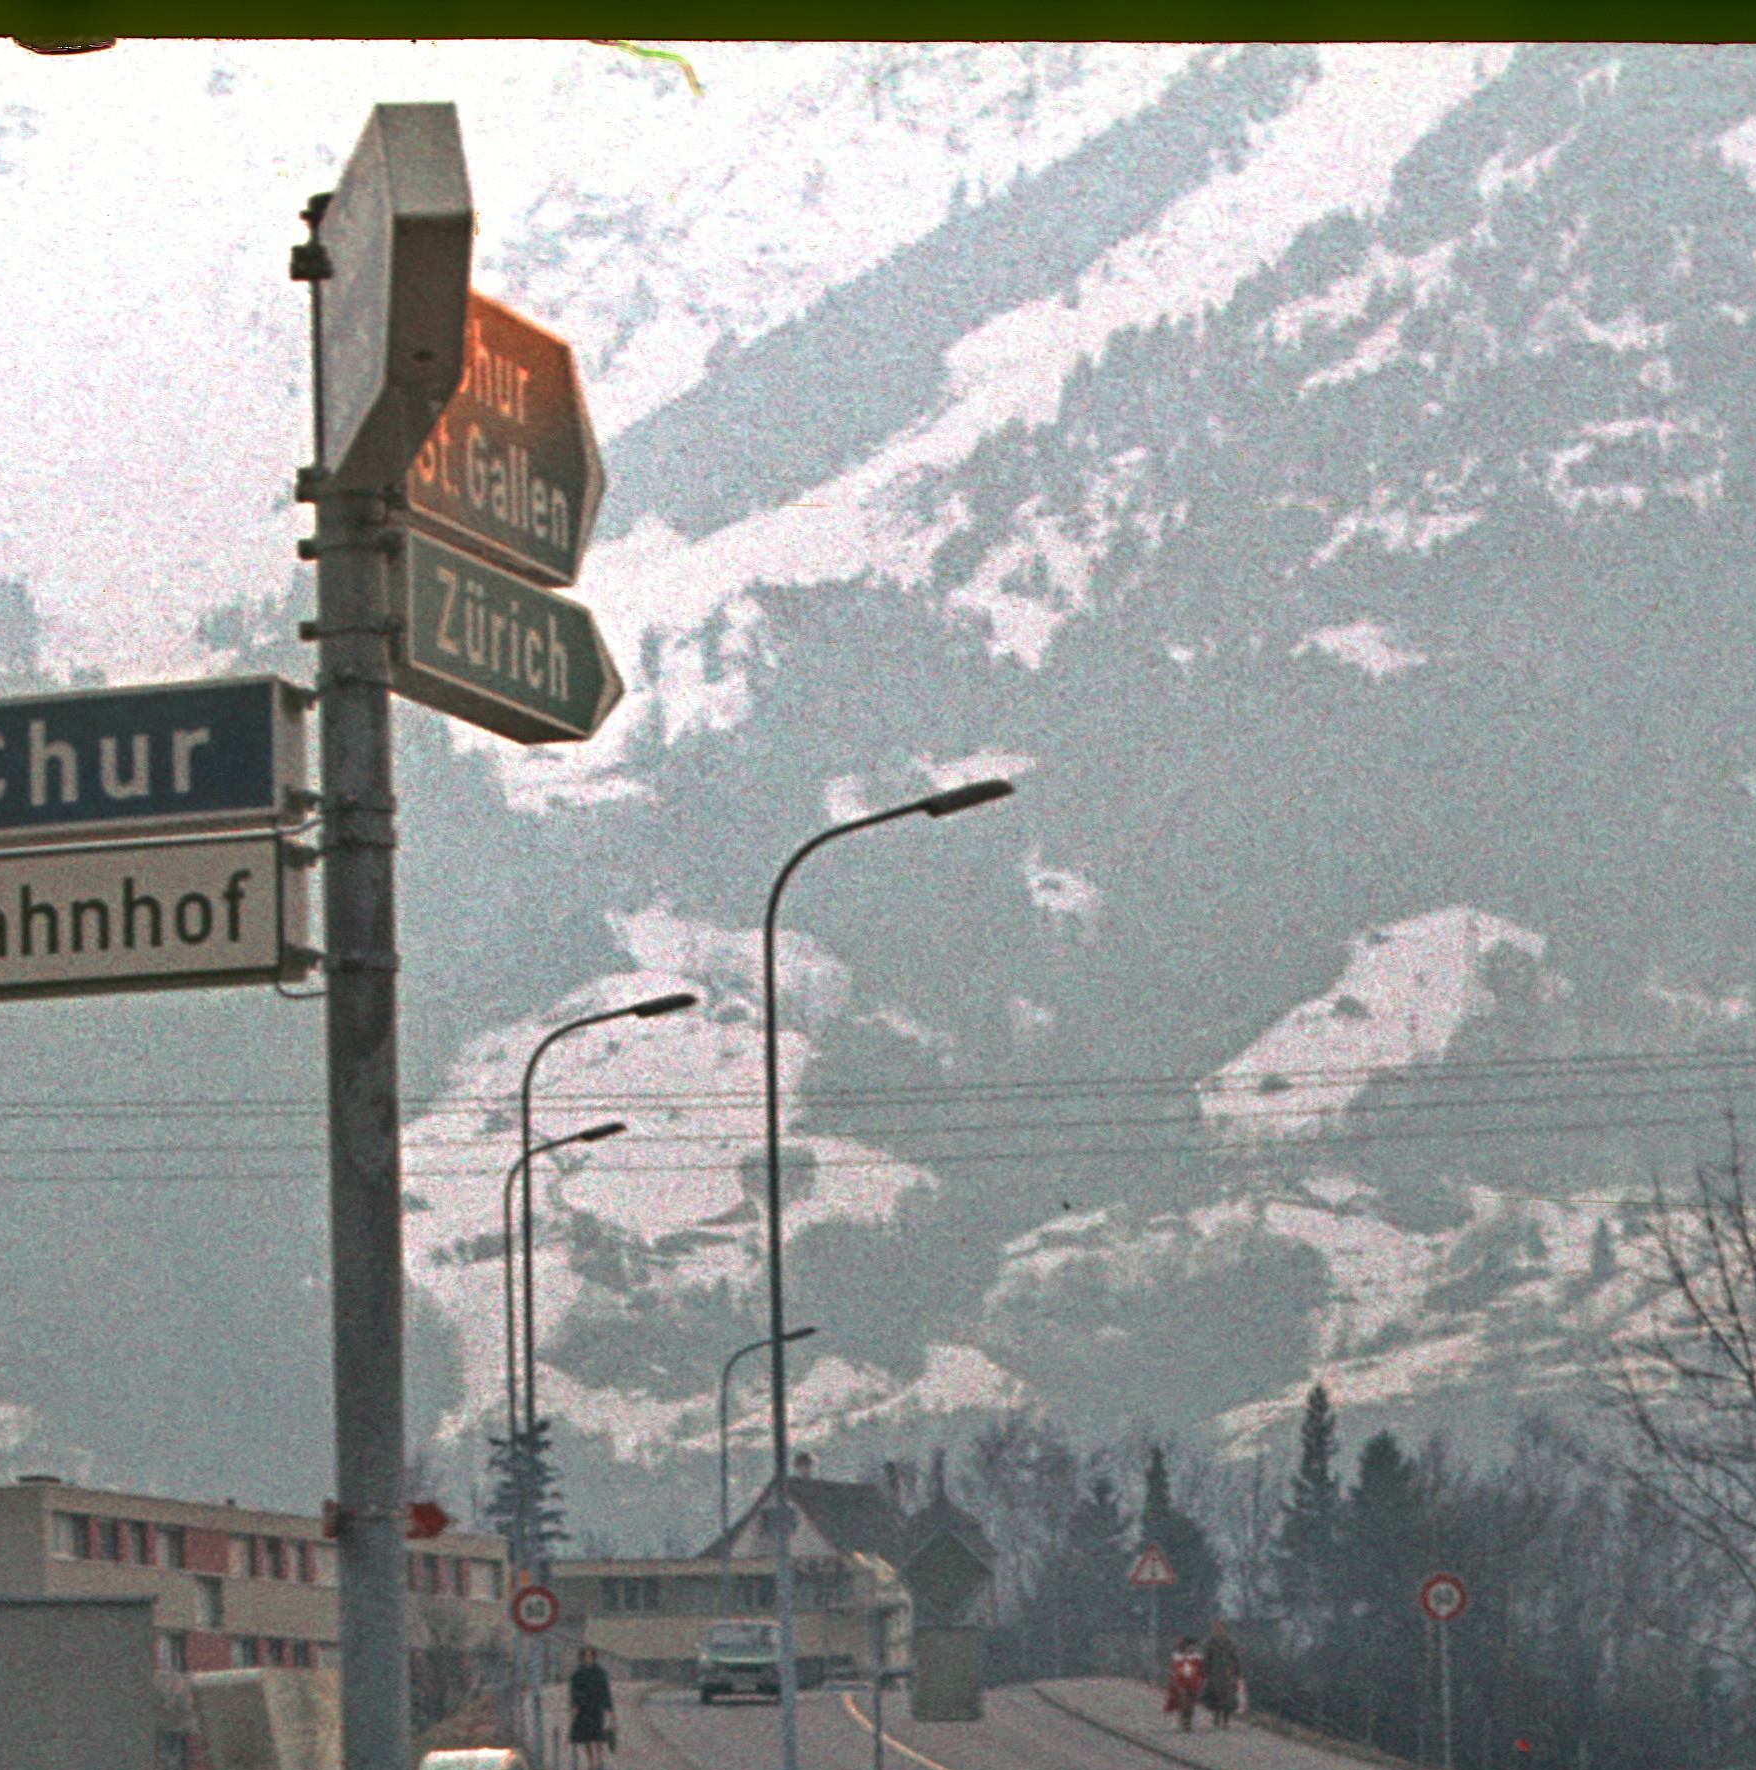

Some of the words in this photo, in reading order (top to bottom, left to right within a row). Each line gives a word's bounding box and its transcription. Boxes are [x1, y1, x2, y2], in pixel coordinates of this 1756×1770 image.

[459, 318, 529, 425] hur
[466, 422, 569, 551] Gallen
[434, 565, 570, 703] Zürich
